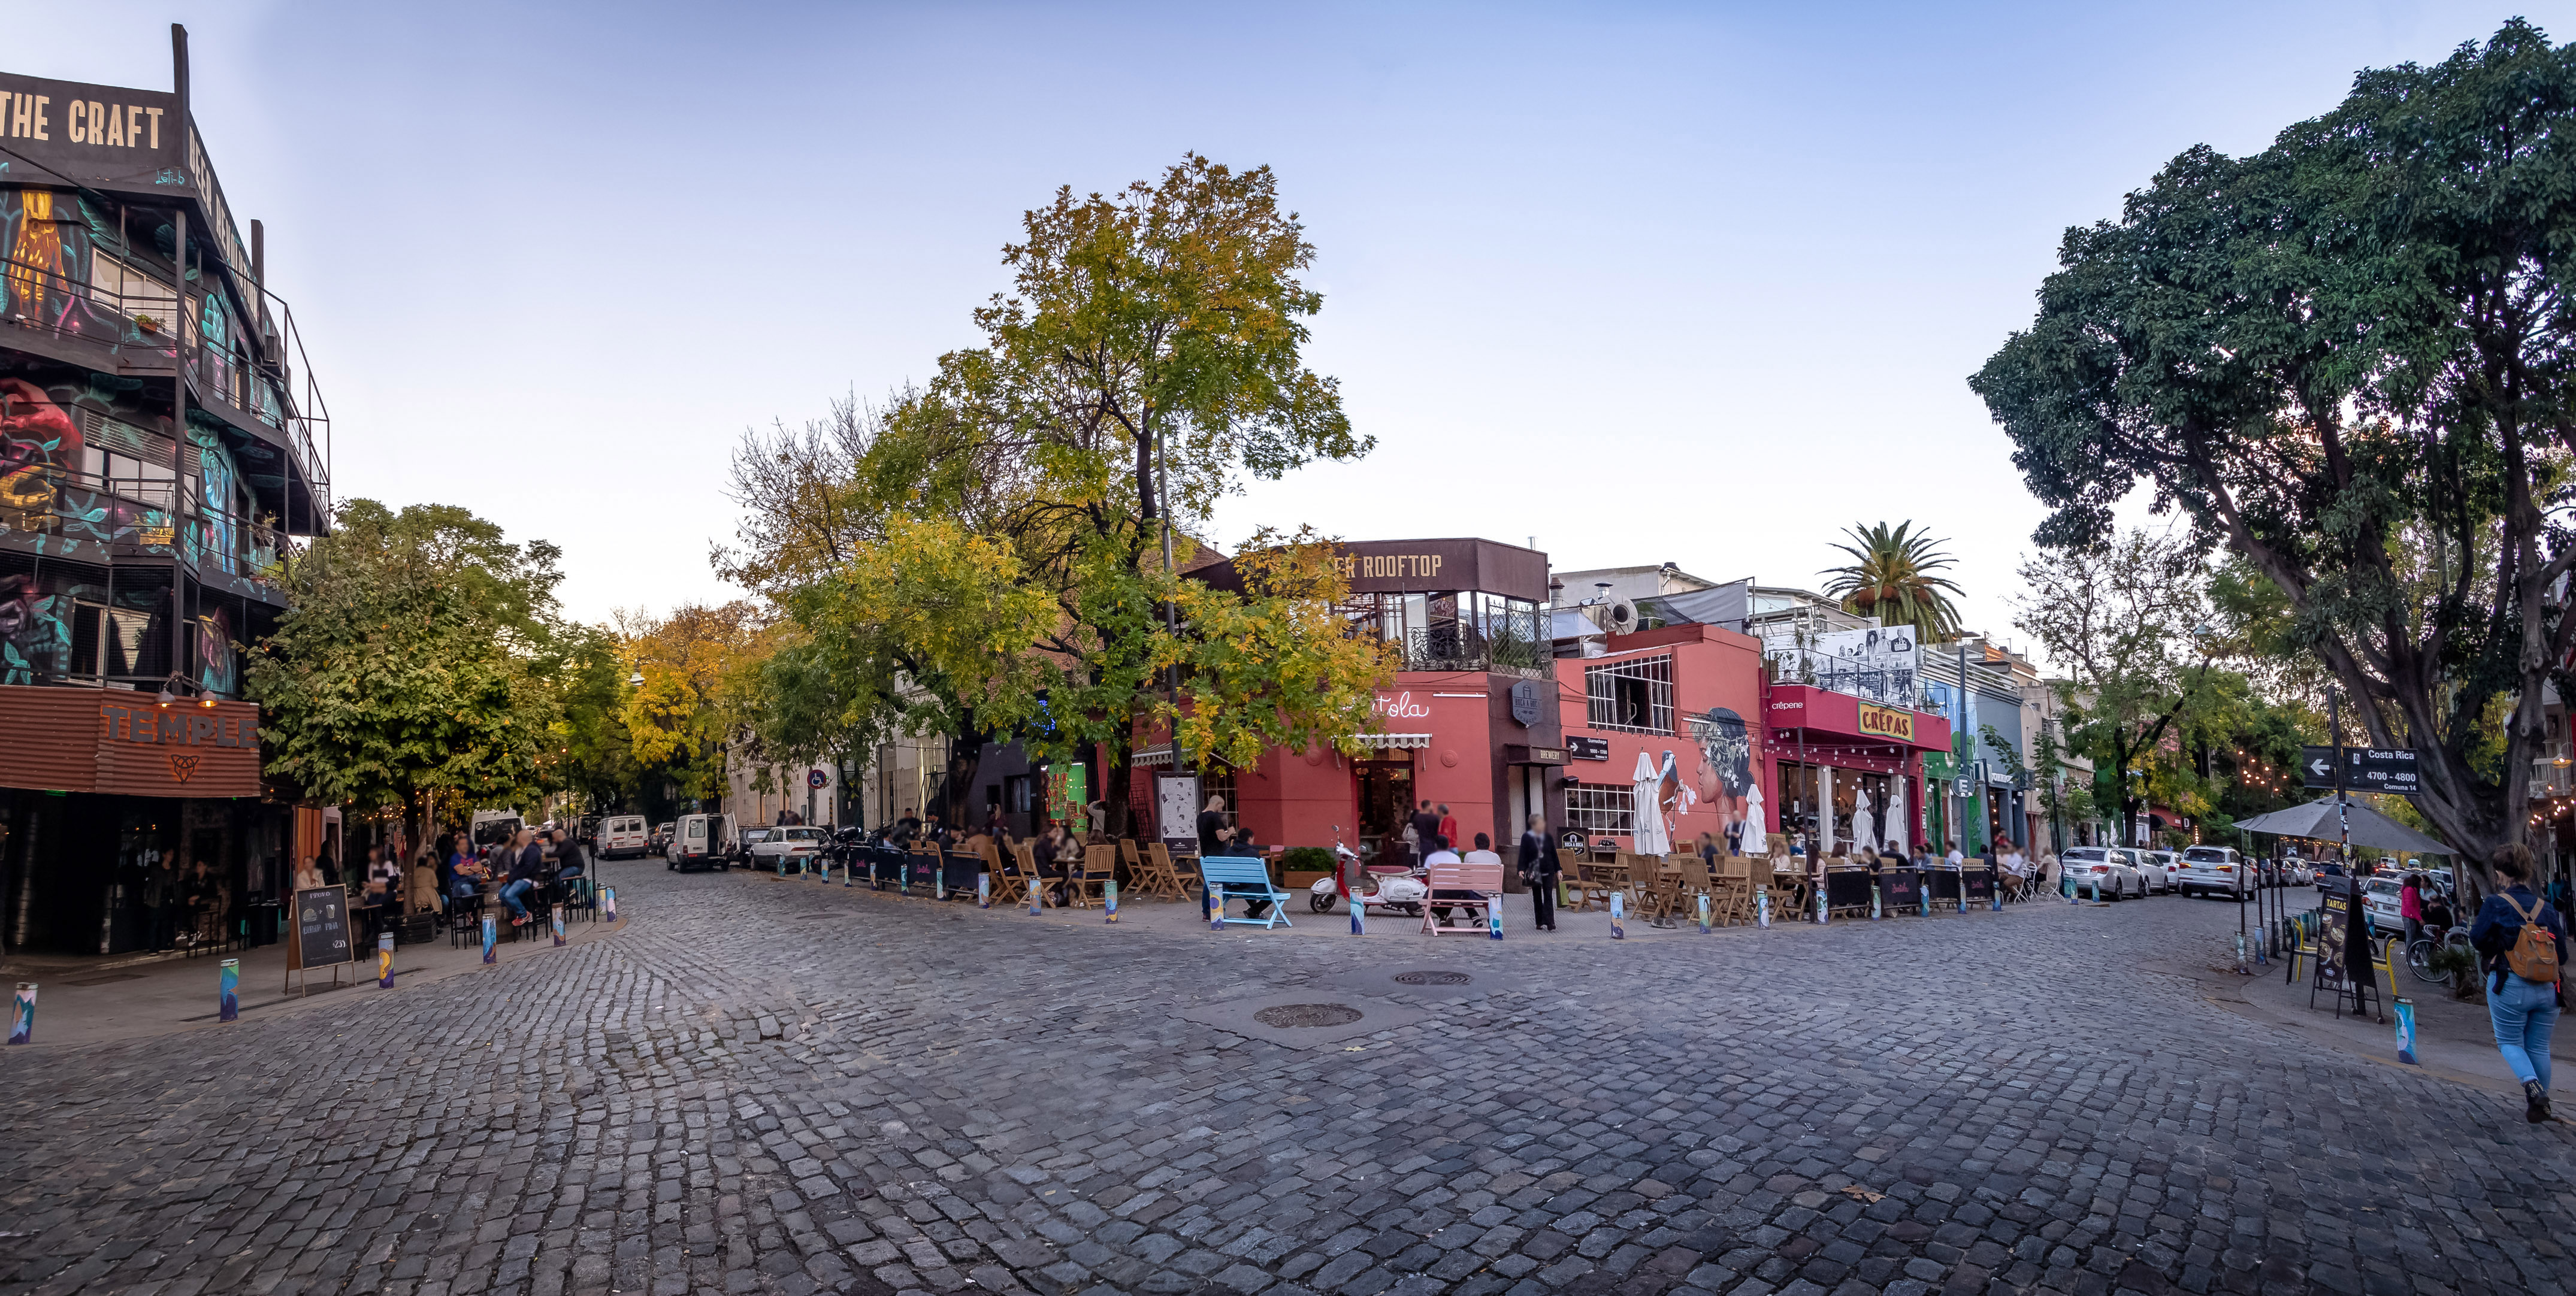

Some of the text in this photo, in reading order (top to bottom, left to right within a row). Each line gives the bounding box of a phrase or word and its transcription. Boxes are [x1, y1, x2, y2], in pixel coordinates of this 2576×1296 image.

[0, 92, 164, 149] THE CRAFT
[189, 125, 212, 217] BEER
[1335, 555, 1442, 579] ER ROOFTOP
[1515, 698, 1526, 707] BOCA
[1771, 701, 1803, 710] crêperie
[101, 705, 259, 749] TEMPLE
[1863, 708, 1909, 737] CRÊPAS
[1540, 750, 1560, 760] BREWERY
[2368, 750, 2414, 760] Costa Rica
[2367, 771, 2387, 780] 4700
[2394, 773, 2416, 782] 4800
[1958, 779, 1968, 792] E
[2327, 898, 2347, 911] TARTAS
